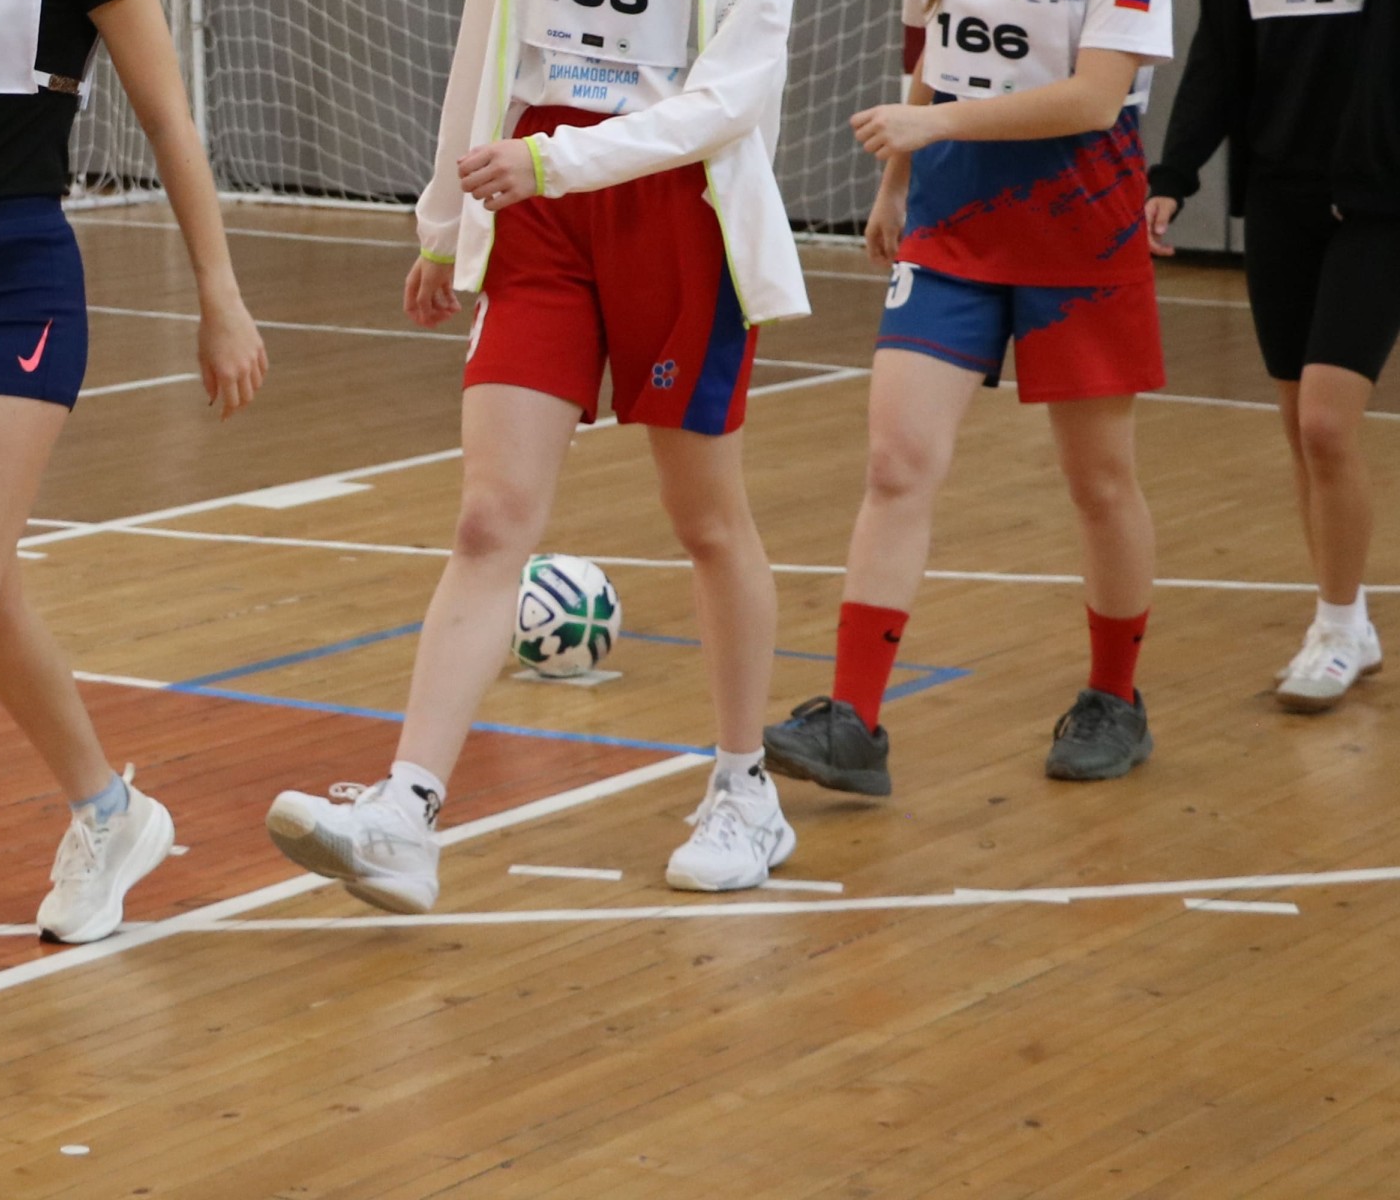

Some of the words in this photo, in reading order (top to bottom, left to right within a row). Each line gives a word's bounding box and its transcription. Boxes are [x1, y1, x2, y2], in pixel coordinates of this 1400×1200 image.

[937, 12, 1030, 59] 166
[549, 64, 640, 85] ДИНАМОВСКАЯ
[572, 84, 608, 100] МИЛЯ
